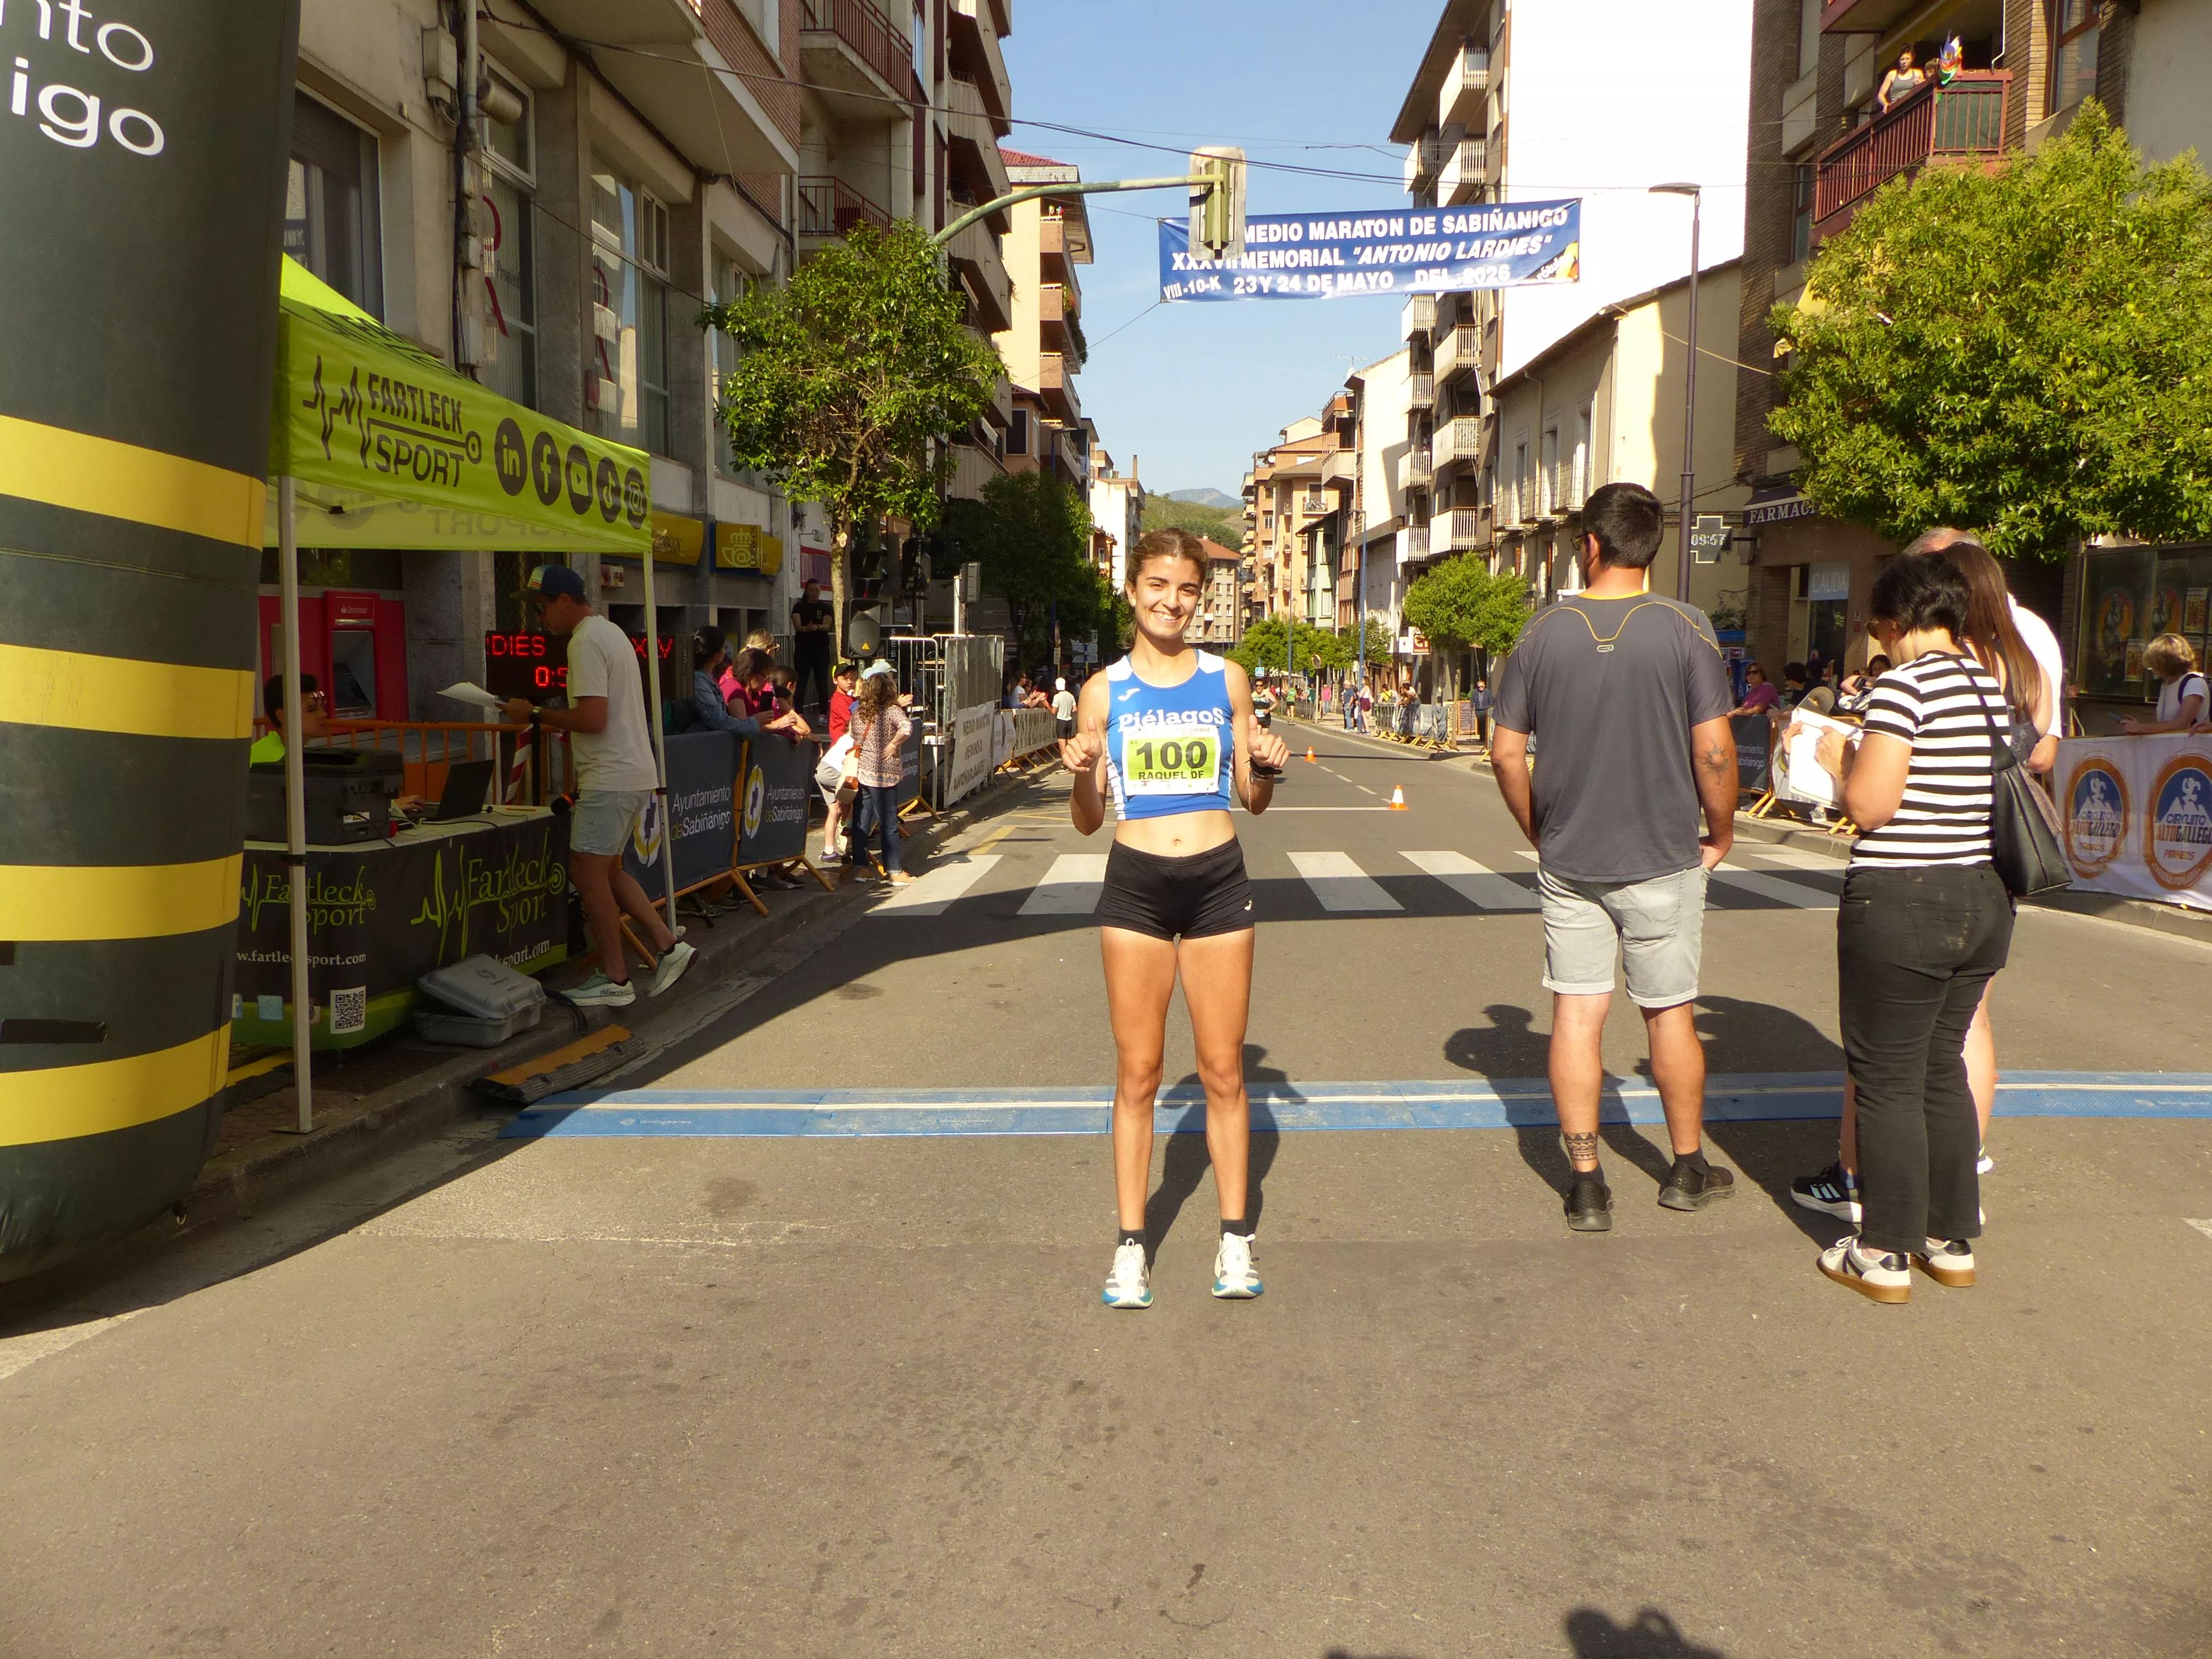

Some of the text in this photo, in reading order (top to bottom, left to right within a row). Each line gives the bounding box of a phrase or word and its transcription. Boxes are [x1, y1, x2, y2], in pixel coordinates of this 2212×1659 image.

[1244, 208, 1568, 243] MEDIO MARATON DE SABIÑANIGO
[1241, 248, 1344, 269] MEMORIAL
[1277, 275, 1301, 293] 24
[1308, 274, 1333, 292] DE
[1338, 270, 1394, 291] MAYO
[368, 372, 463, 434] FARTLECK
[374, 434, 465, 487] SPORT
[1749, 499, 1817, 524] FARMACI
[749, 525, 758, 567] CORREOS
[1136, 740, 1208, 770] 100
[1138, 771, 1187, 780] RAQUEL
[672, 785, 731, 817] Ayuntamiento
[767, 785, 805, 804] Ayuntamiento
[2166, 813, 2206, 826] CIRCUITO
[265, 865, 366, 903] Fatleck
